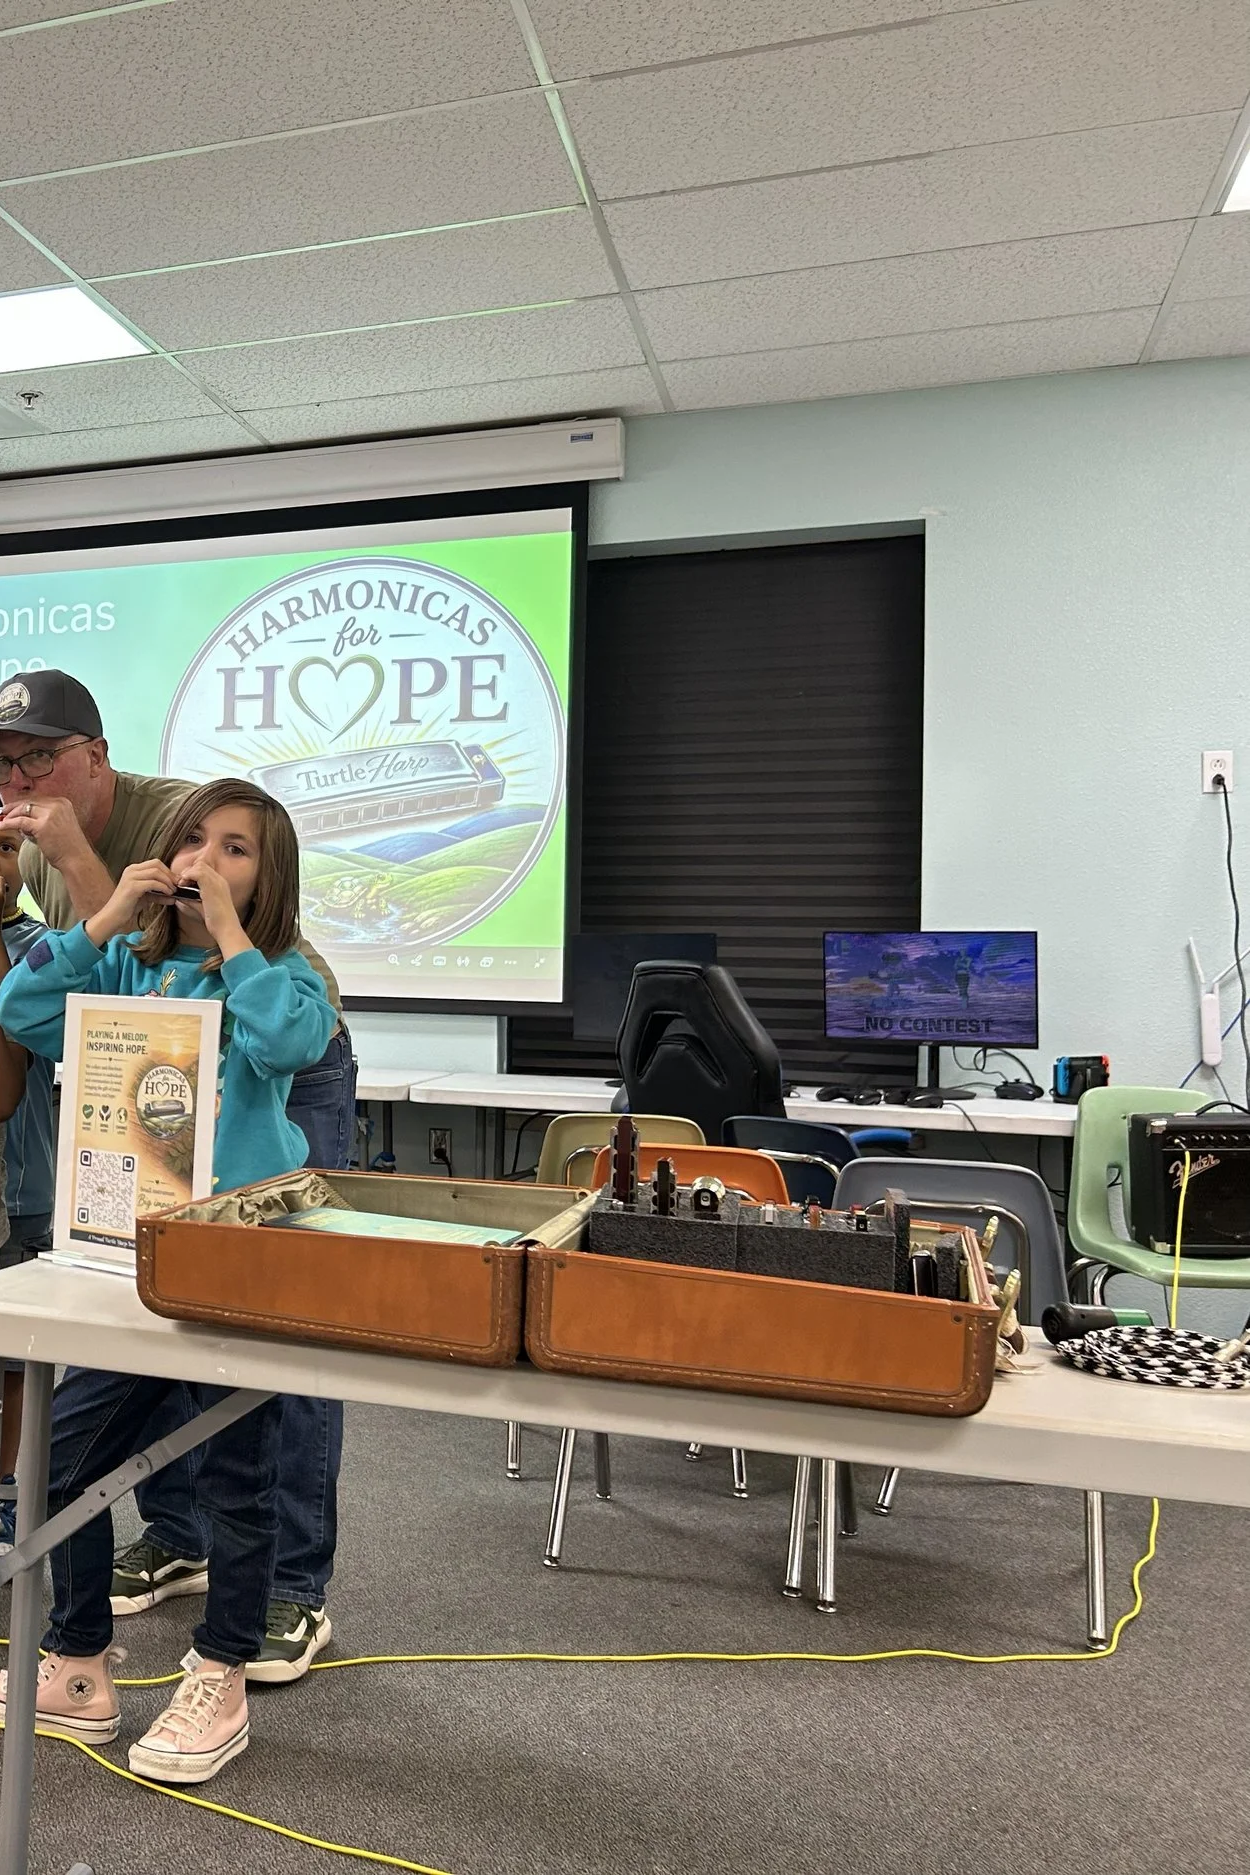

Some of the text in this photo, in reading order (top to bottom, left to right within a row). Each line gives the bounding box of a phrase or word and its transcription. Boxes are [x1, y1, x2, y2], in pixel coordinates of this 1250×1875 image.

[225, 580, 498, 662] HARMONICAS
[333, 616, 382, 656] for
[863, 1016, 993, 1033] NO CONTEST
[87, 1030, 149, 1042] PLAYING A MELODY.
[86, 1042, 149, 1055] INSPIRING HOPE.
[146, 1068, 185, 1083] HARMONICAS
